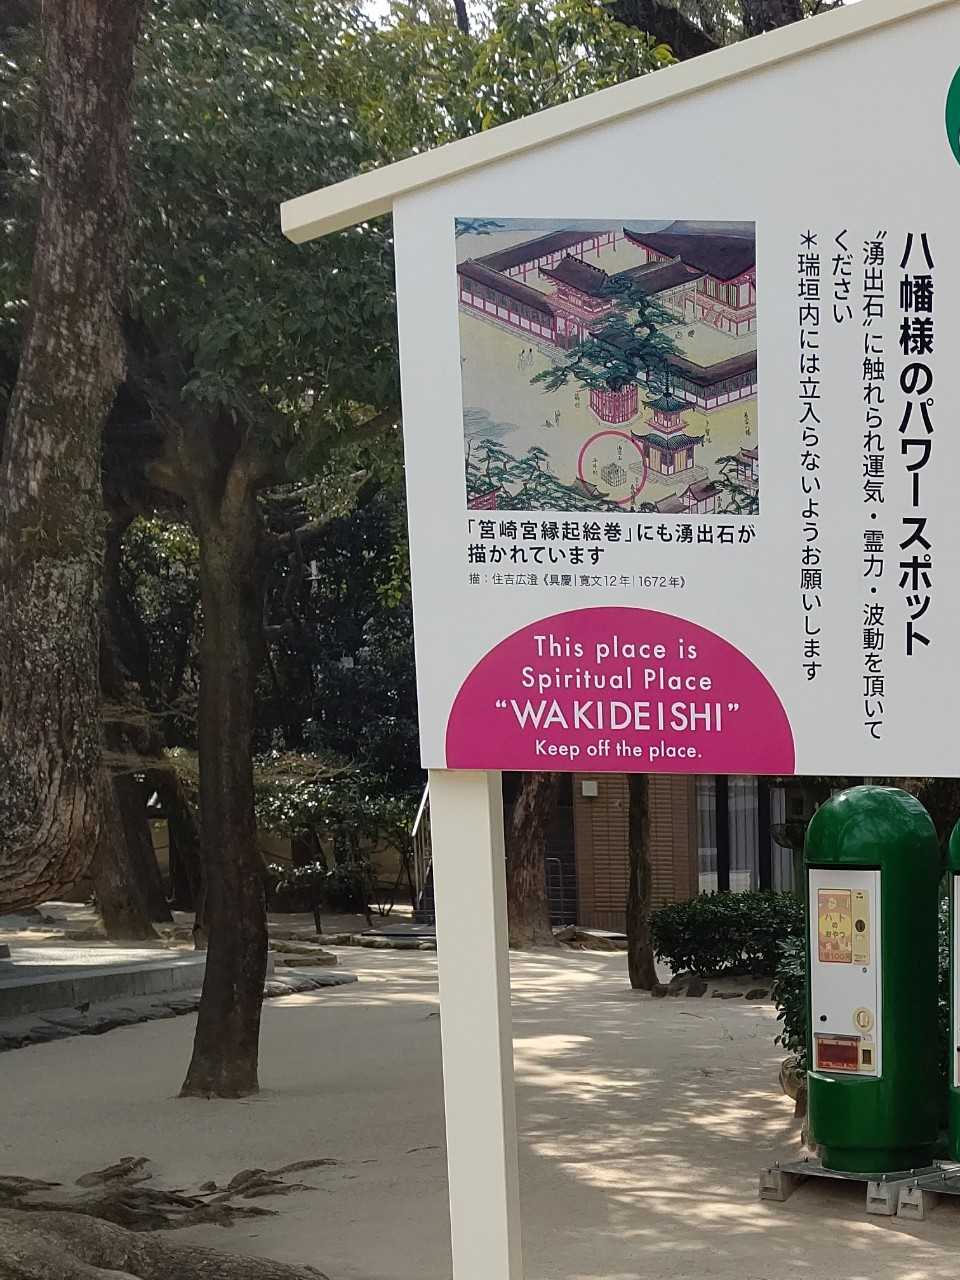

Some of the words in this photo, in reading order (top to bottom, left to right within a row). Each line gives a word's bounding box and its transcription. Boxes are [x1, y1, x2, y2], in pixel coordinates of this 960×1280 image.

[832, 229, 853, 324] ください
[899, 232, 934, 656] 八幡様のパワースポット
[468, 545, 605, 565] 描かれています
[534, 634, 584, 658] This
[597, 635, 666, 664] place
[679, 638, 697, 659] is
[521, 667, 632, 694] Spiritual
[645, 668, 712, 691] Place
[535, 740, 580, 761] Keep
[586, 738, 610, 757] off
[616, 739, 643, 757] the
[649, 740, 702, 762] place.
